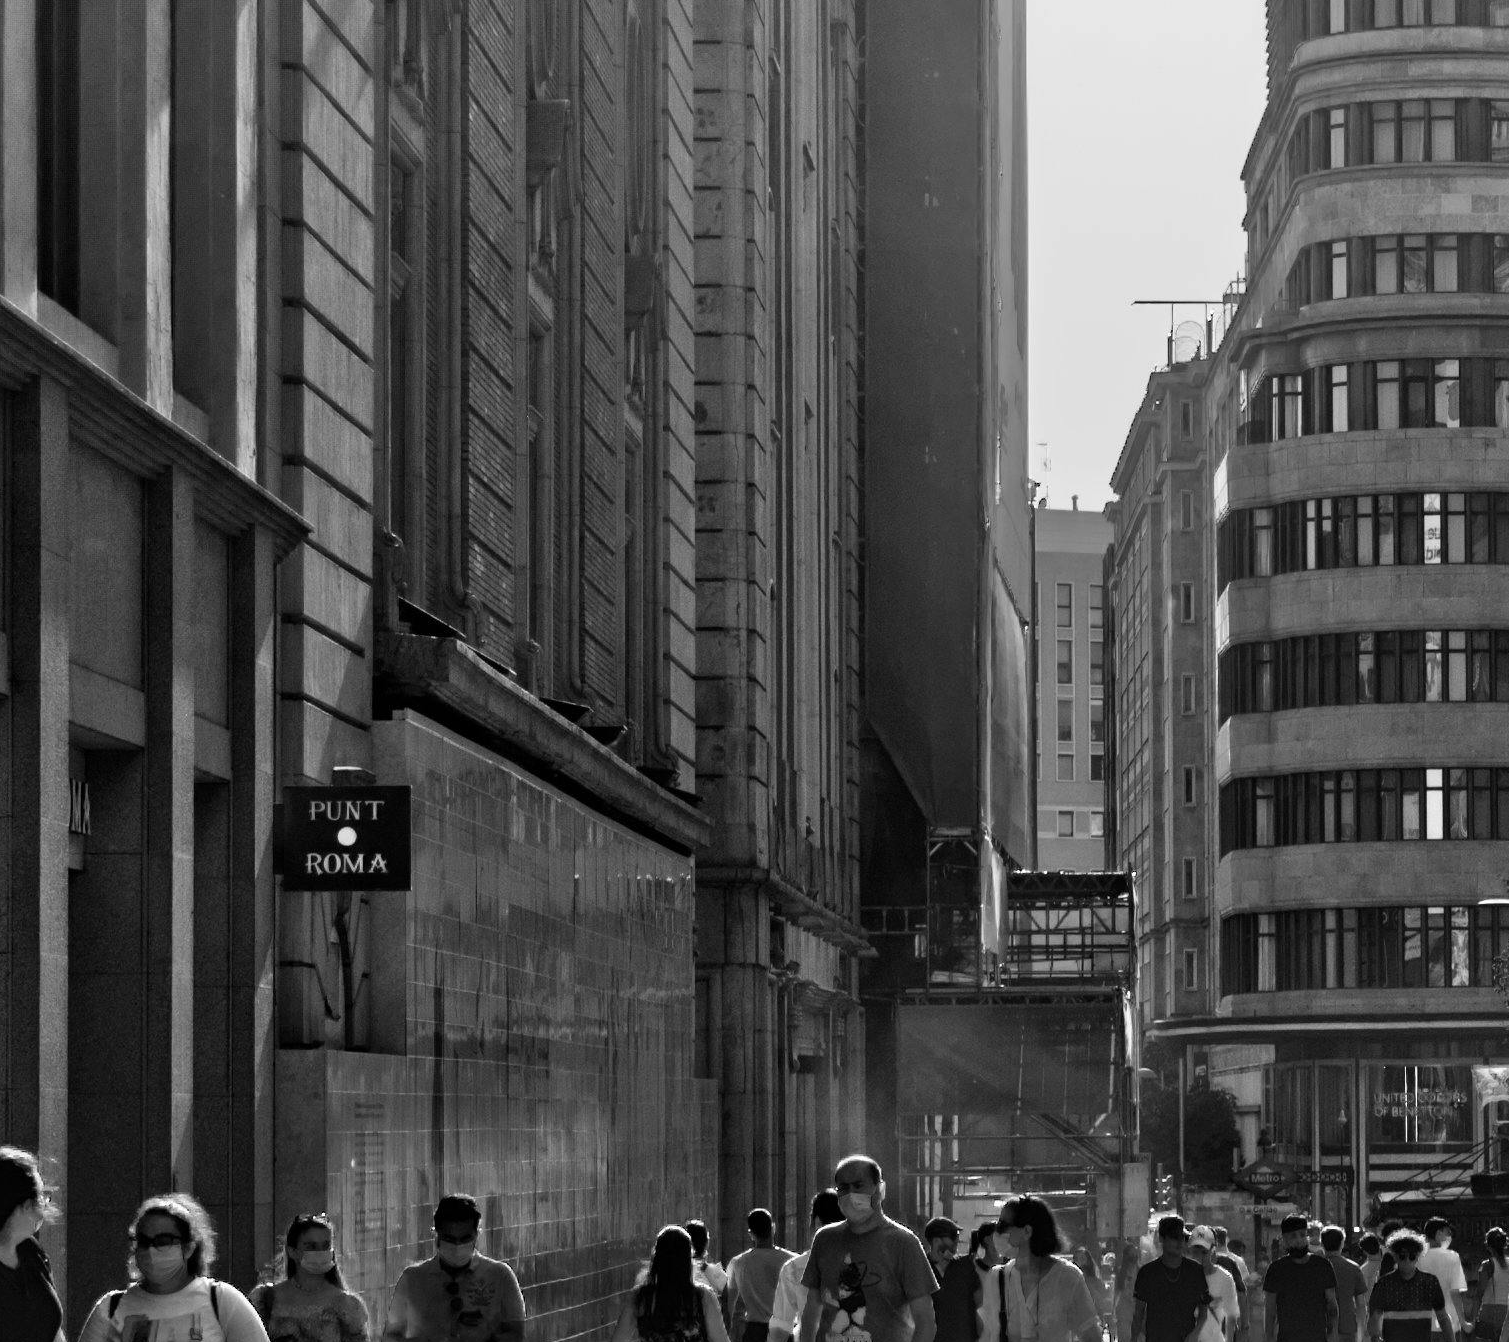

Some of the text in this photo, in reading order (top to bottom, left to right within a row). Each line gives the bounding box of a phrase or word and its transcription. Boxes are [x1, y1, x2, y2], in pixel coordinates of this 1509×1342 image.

[309, 800, 385, 821] PUNT
[305, 853, 388, 876] ROMA
[1250, 1172, 1281, 1185] Metro
